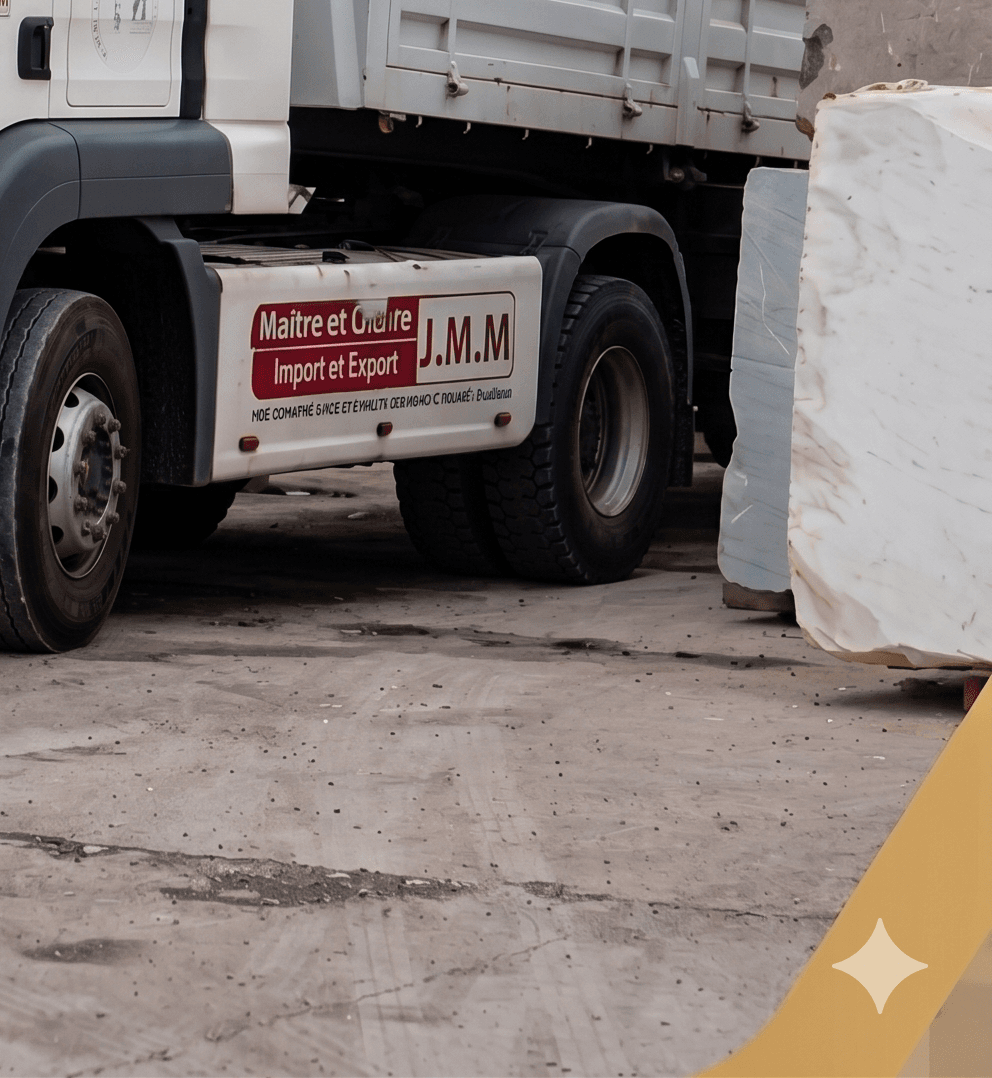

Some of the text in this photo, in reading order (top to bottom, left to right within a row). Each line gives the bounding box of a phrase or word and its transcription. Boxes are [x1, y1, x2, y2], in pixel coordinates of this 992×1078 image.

[327, 308, 348, 336] et
[274, 350, 399, 390] Import et Export
